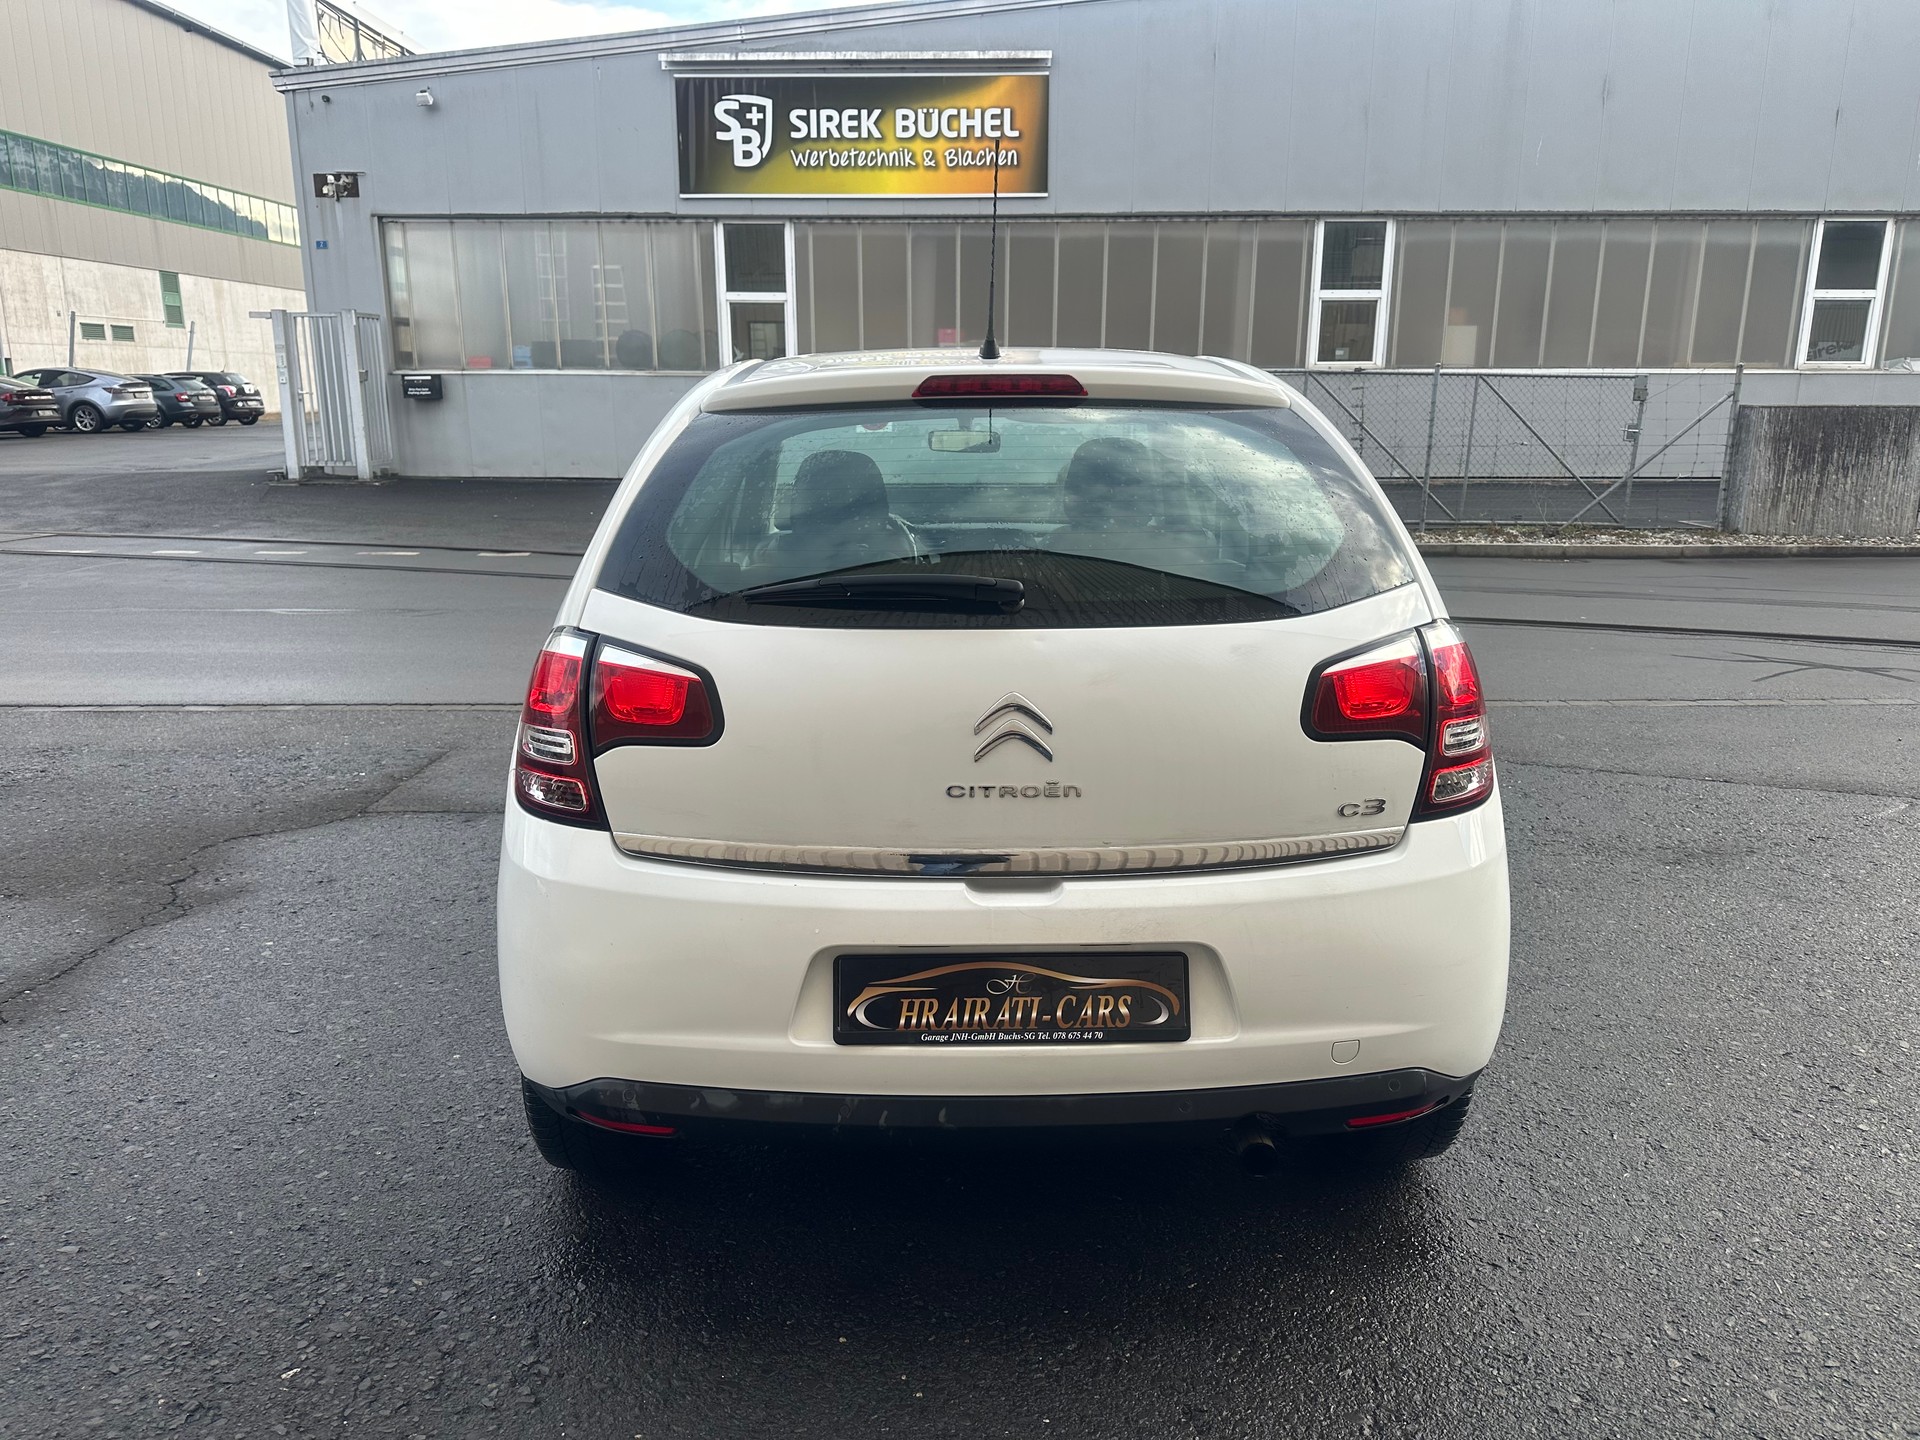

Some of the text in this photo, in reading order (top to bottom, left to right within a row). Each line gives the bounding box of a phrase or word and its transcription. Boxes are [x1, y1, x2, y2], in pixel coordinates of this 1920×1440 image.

[789, 107, 1019, 139] SIREK BÜCHEL
[791, 147, 1018, 168] Werbetechnik & Blachen
[921, 1031, 1104, 1042] Garage JNH-GmbH Buchs-SG Tel. 078 675 44 70
